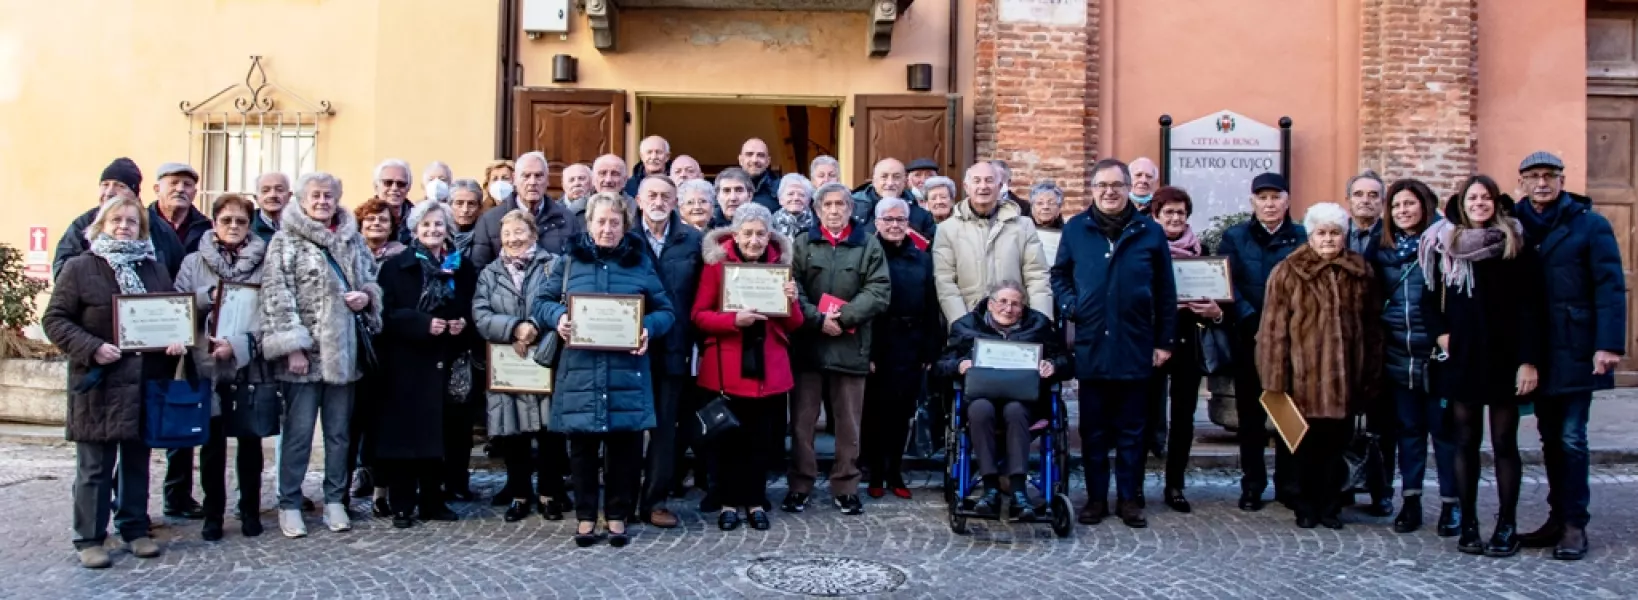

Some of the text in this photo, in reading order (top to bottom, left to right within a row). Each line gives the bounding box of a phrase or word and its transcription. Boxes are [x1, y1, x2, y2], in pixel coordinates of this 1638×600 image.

[1232, 138, 1260, 146] BUSCA
[1179, 156, 1273, 171] TEATRO CIVICO
